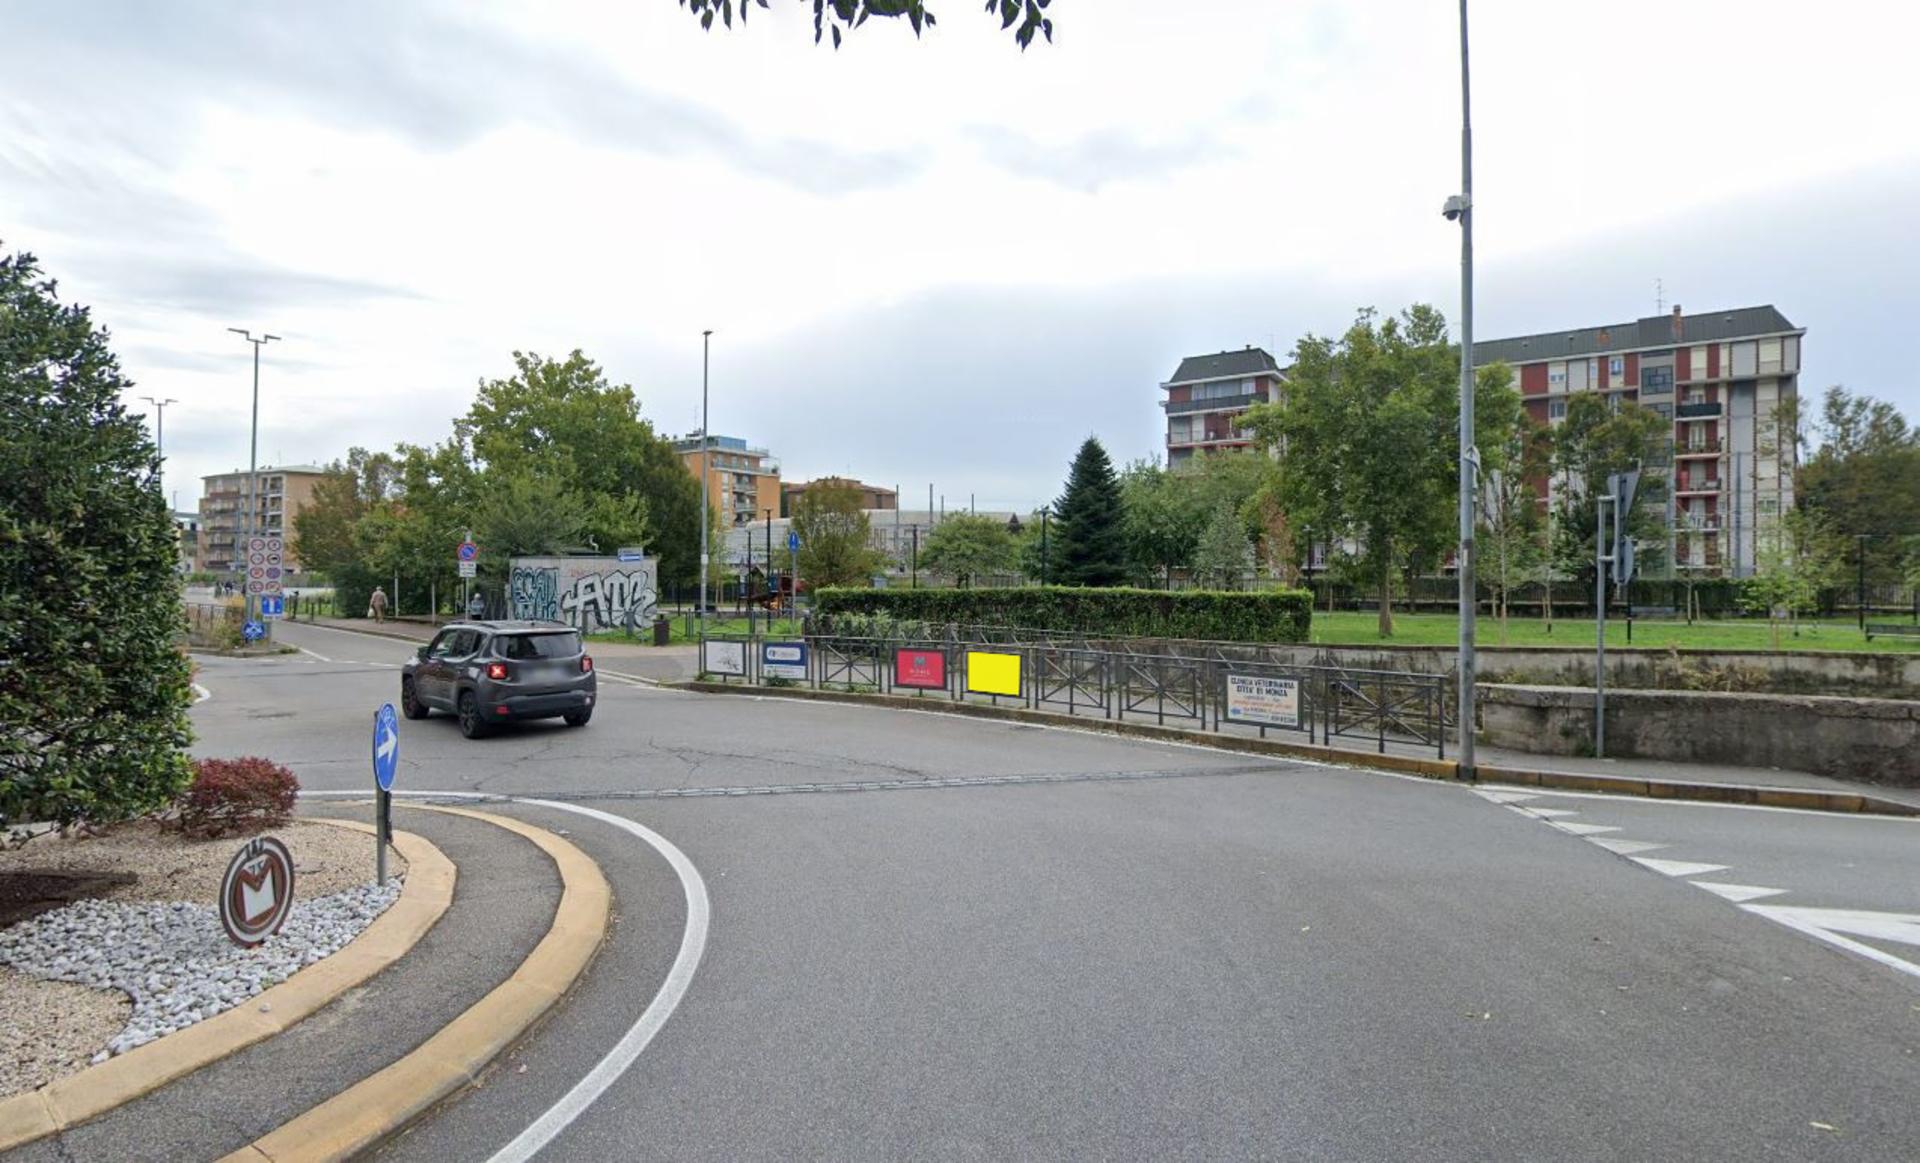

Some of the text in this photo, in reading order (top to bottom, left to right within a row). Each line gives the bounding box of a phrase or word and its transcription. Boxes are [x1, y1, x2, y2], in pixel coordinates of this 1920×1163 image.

[1231, 677, 1295, 689] CLINICA VETERINARIA
[1257, 687, 1264, 695] DI
[1265, 688, 1288, 697] MONZA
